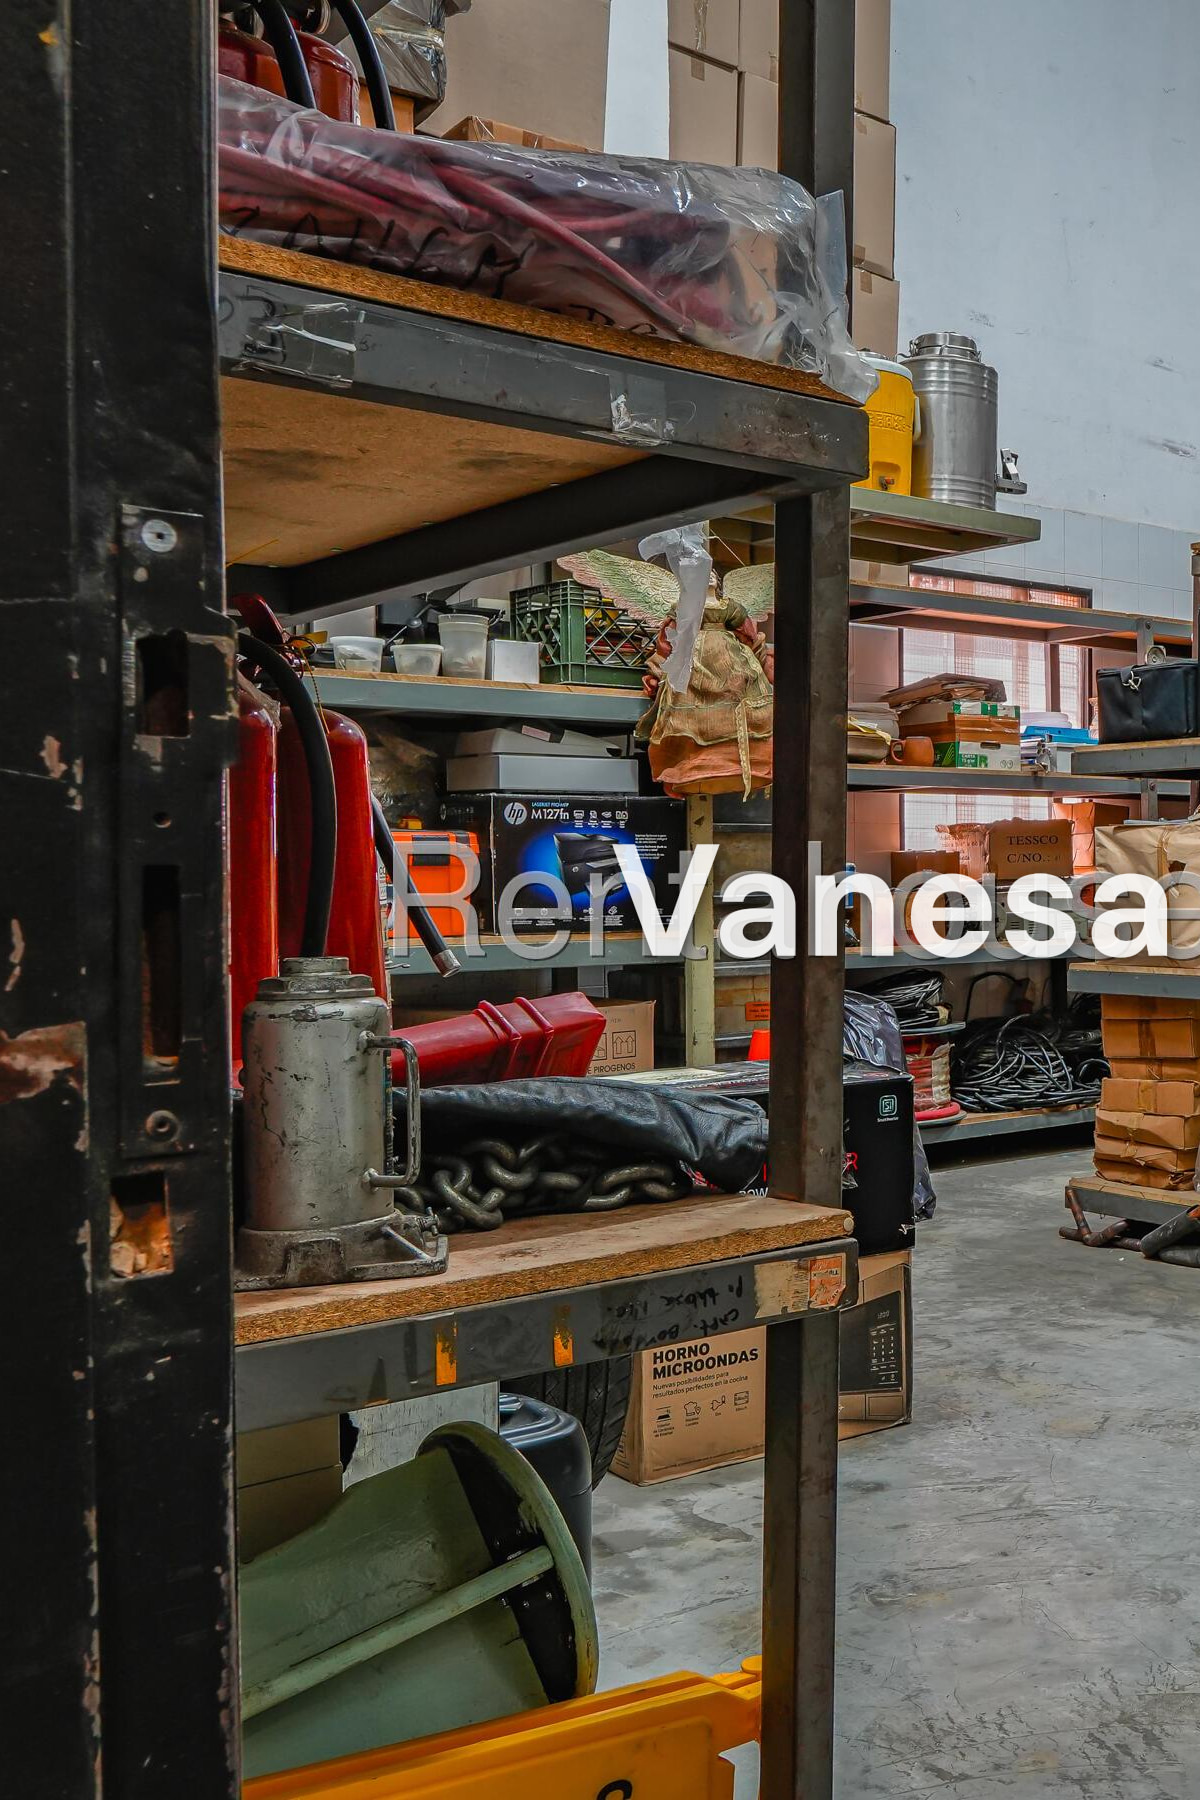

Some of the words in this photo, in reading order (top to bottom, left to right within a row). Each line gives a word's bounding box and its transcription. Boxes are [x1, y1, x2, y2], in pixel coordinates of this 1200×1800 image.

[531, 808, 570, 820] M127fn
[1006, 834, 1059, 846] TESSCO
[593, 1062, 636, 1073] PIROGENOS
[652, 1342, 710, 1365] HORNO
[652, 1348, 759, 1380] MICROONDAS
[652, 1382, 676, 1391] Nuevas
[676, 1374, 715, 1387] posibilidades
[716, 1371, 729, 1380] para
[652, 1388, 685, 1399] resultados
[685, 1382, 714, 1394] perfectos
[728, 1375, 748, 1384] cocina
